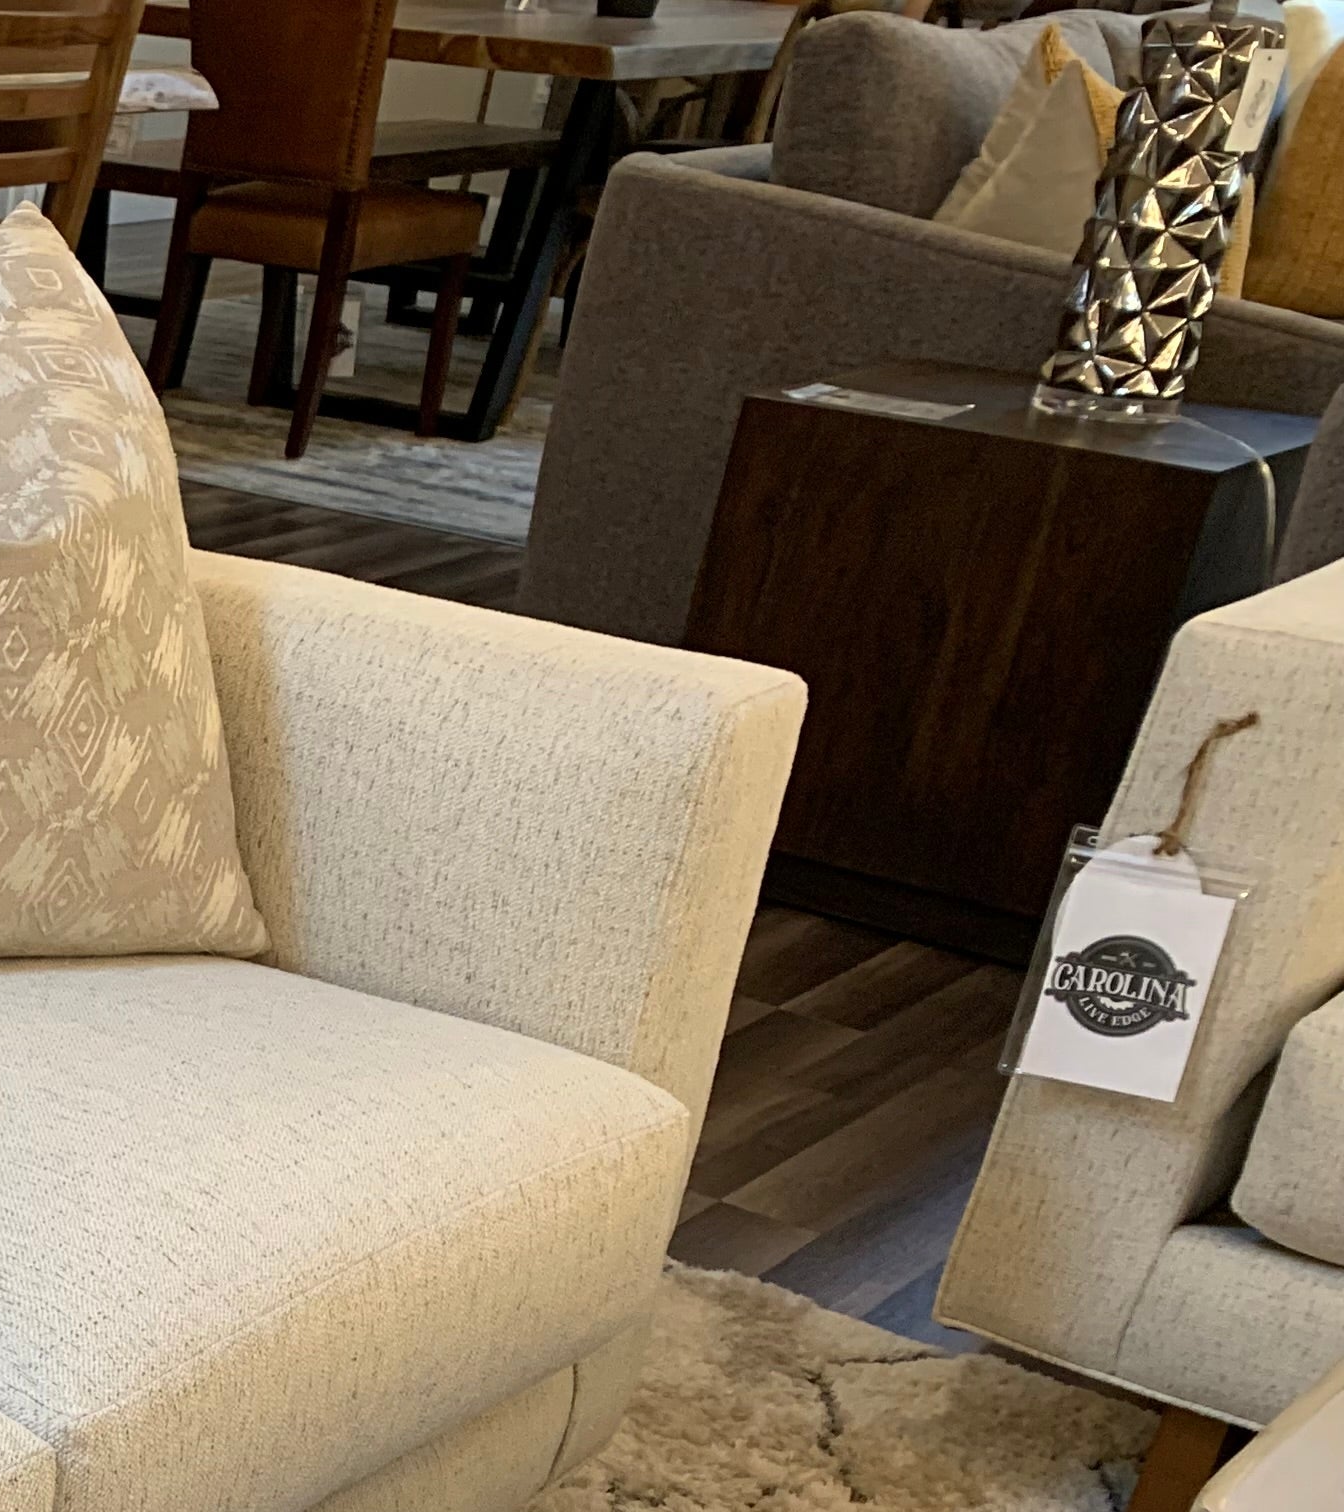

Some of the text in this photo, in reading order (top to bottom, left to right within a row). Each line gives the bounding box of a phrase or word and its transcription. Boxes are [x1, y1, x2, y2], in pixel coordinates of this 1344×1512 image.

[1054, 963, 1187, 1013] CAROLINA
[1078, 996, 1152, 1026] LIVE EDGE
